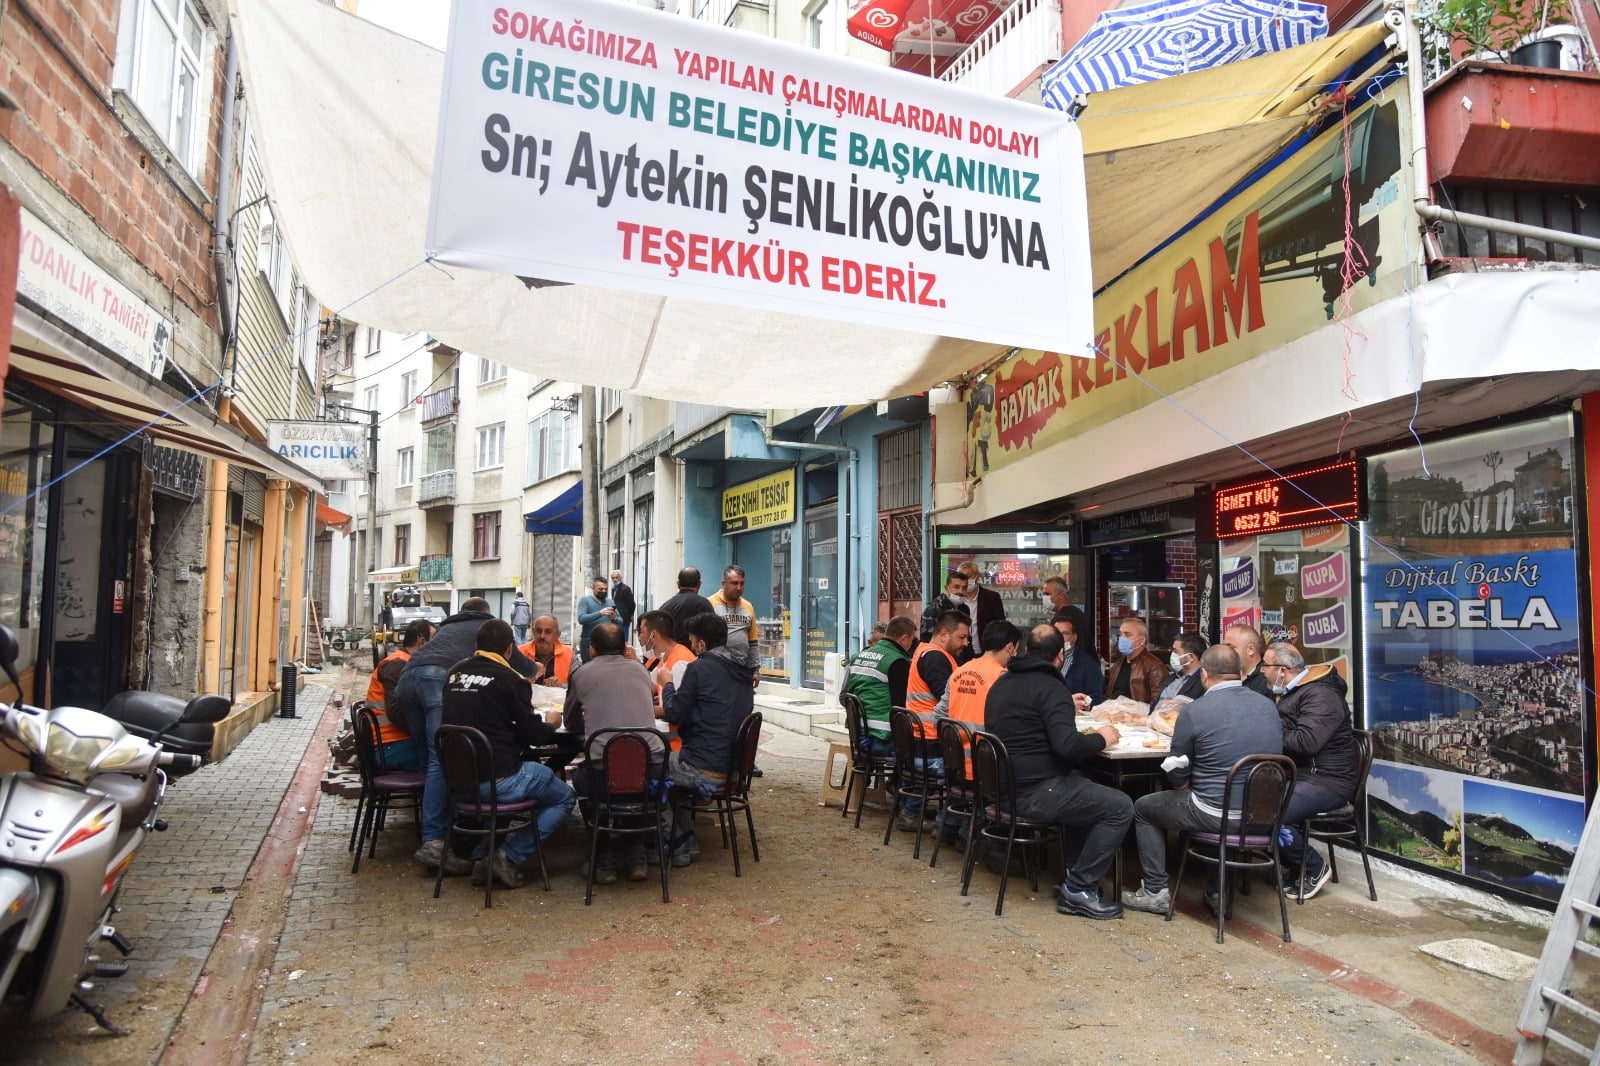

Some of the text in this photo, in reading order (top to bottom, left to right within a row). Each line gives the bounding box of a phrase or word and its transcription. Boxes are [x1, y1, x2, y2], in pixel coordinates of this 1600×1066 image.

[493, 8, 1039, 158] SOKAĞIMIZA YAPILAN ÇALIŞMALARDAN DOLAYI
[482, 48, 1041, 204] GİRESUN BELEDİYE BAŞKANIMIZ
[481, 113, 1050, 271] Sn; Aytekin ŞENLİKOĞLU'NA
[617, 222, 947, 309] TEŞEKKÜR EDERİZ.
[102, 284, 151, 341] TAMİRİ
[1000, 209, 1266, 432] BAYRAK REKLAM
[278, 444, 358, 459] ARICILIK
[725, 479, 790, 518] ÖZER SIHHİ TESİSAT
[1219, 492, 1253, 511] İSMET
[1421, 488, 1516, 535] Giresun
[764, 513, 773, 524] 777
[1234, 513, 1260, 531] 0532
[1284, 562, 1295, 570] WC
[1305, 563, 1337, 587] KUPA
[1385, 555, 1541, 594] Dijital Baskı
[1308, 613, 1339, 636] DUBA
[1374, 597, 1562, 630] TABELA
